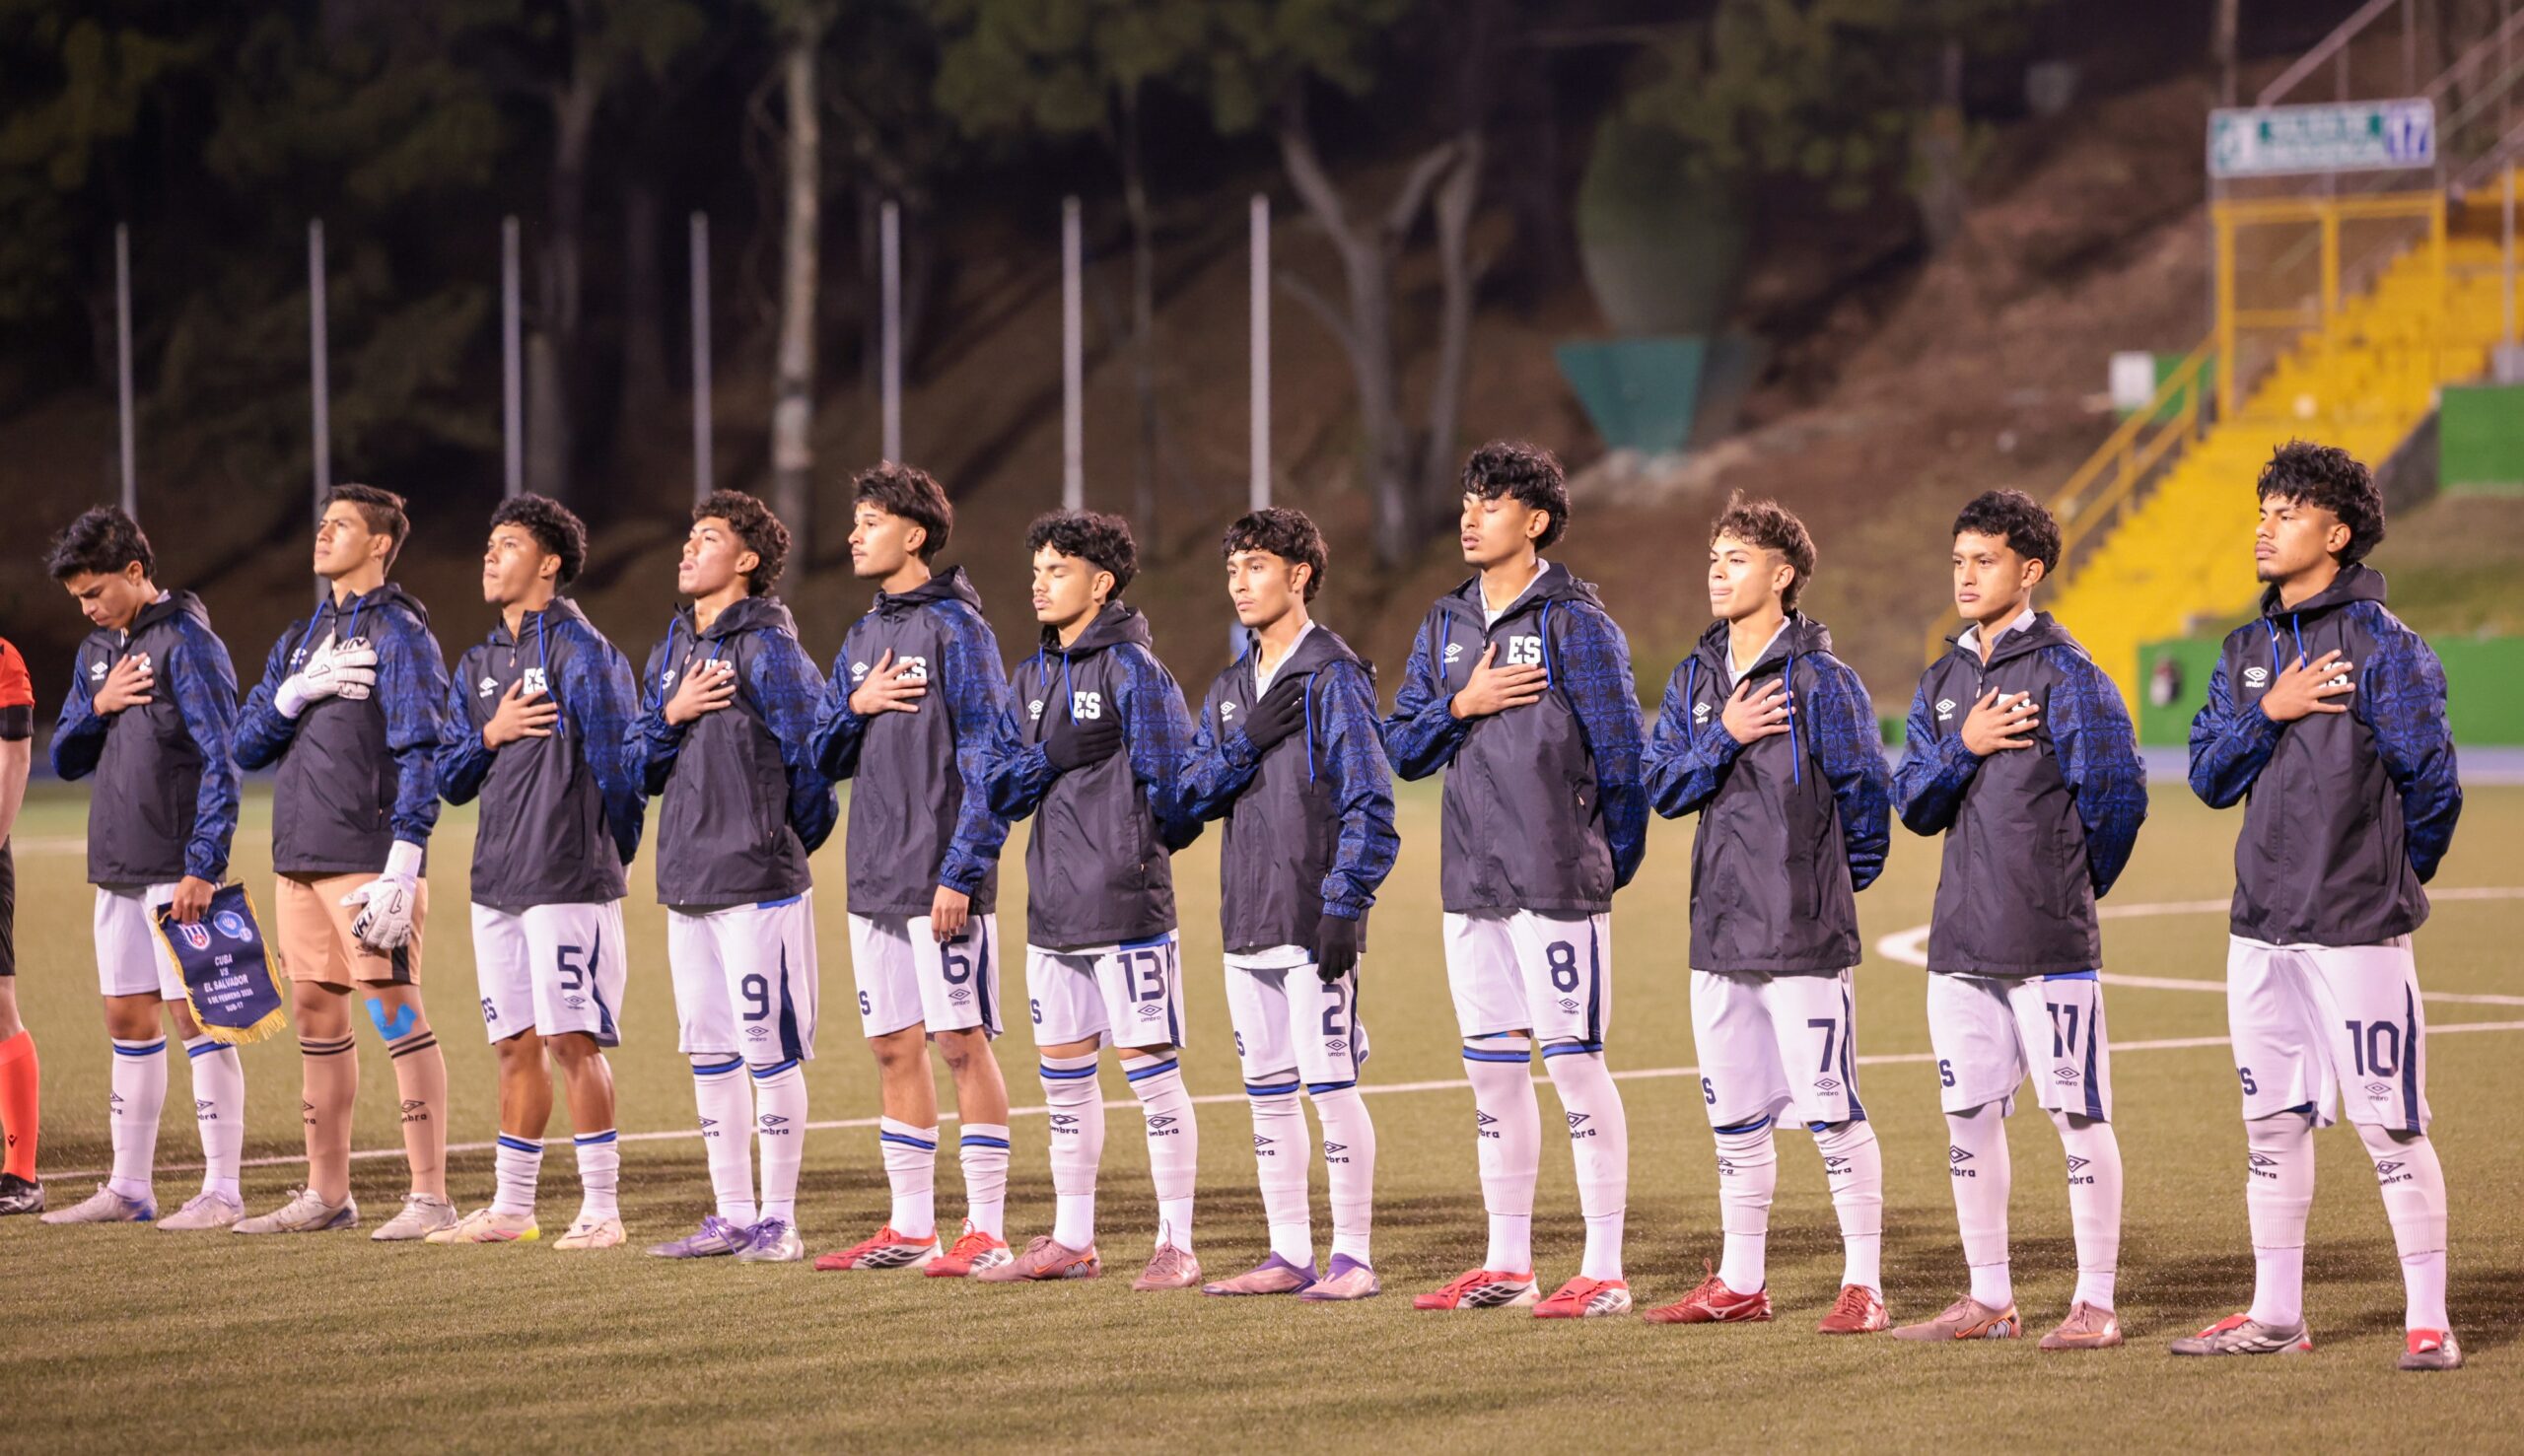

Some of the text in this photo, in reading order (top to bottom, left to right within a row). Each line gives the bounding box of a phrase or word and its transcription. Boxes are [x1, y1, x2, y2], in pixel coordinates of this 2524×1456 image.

[1507, 636, 1541, 664] ES
[524, 667, 548, 694] ES
[1073, 691, 1101, 720] ES
[214, 953, 234, 967] CUBA
[557, 944, 584, 990] 5
[941, 935, 969, 985] 6
[1117, 950, 1165, 1003] 13
[1546, 940, 1579, 993] 8
[203, 974, 248, 993] EL SALVADOR
[741, 974, 769, 1020] 9
[481, 997, 498, 1023] ES
[1322, 984, 1346, 1035] 2
[1807, 1018, 1836, 1073] 7
[2346, 1020, 2399, 1077] 10
[2237, 1067, 2257, 1095] S
